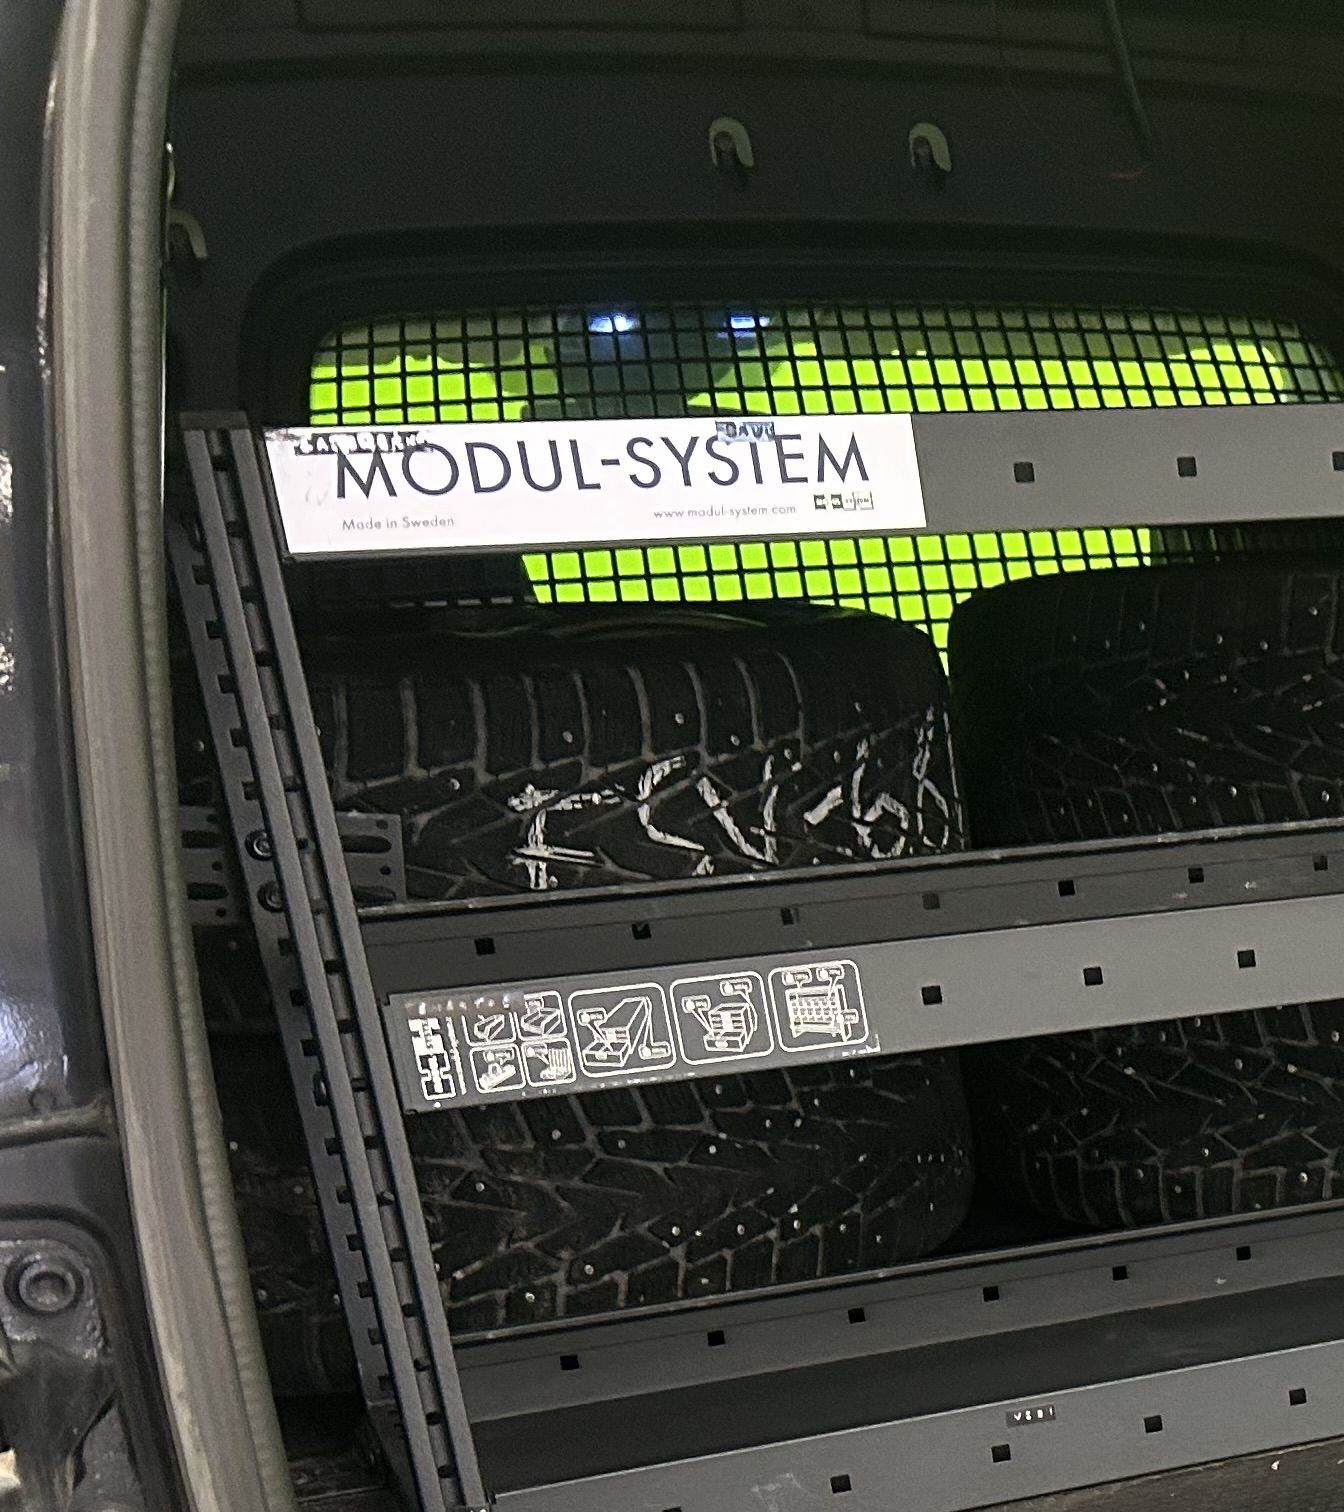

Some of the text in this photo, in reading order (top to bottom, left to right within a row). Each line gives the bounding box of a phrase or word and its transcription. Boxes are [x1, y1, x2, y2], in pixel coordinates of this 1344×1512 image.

[340, 514, 456, 532] Made in Sweden
